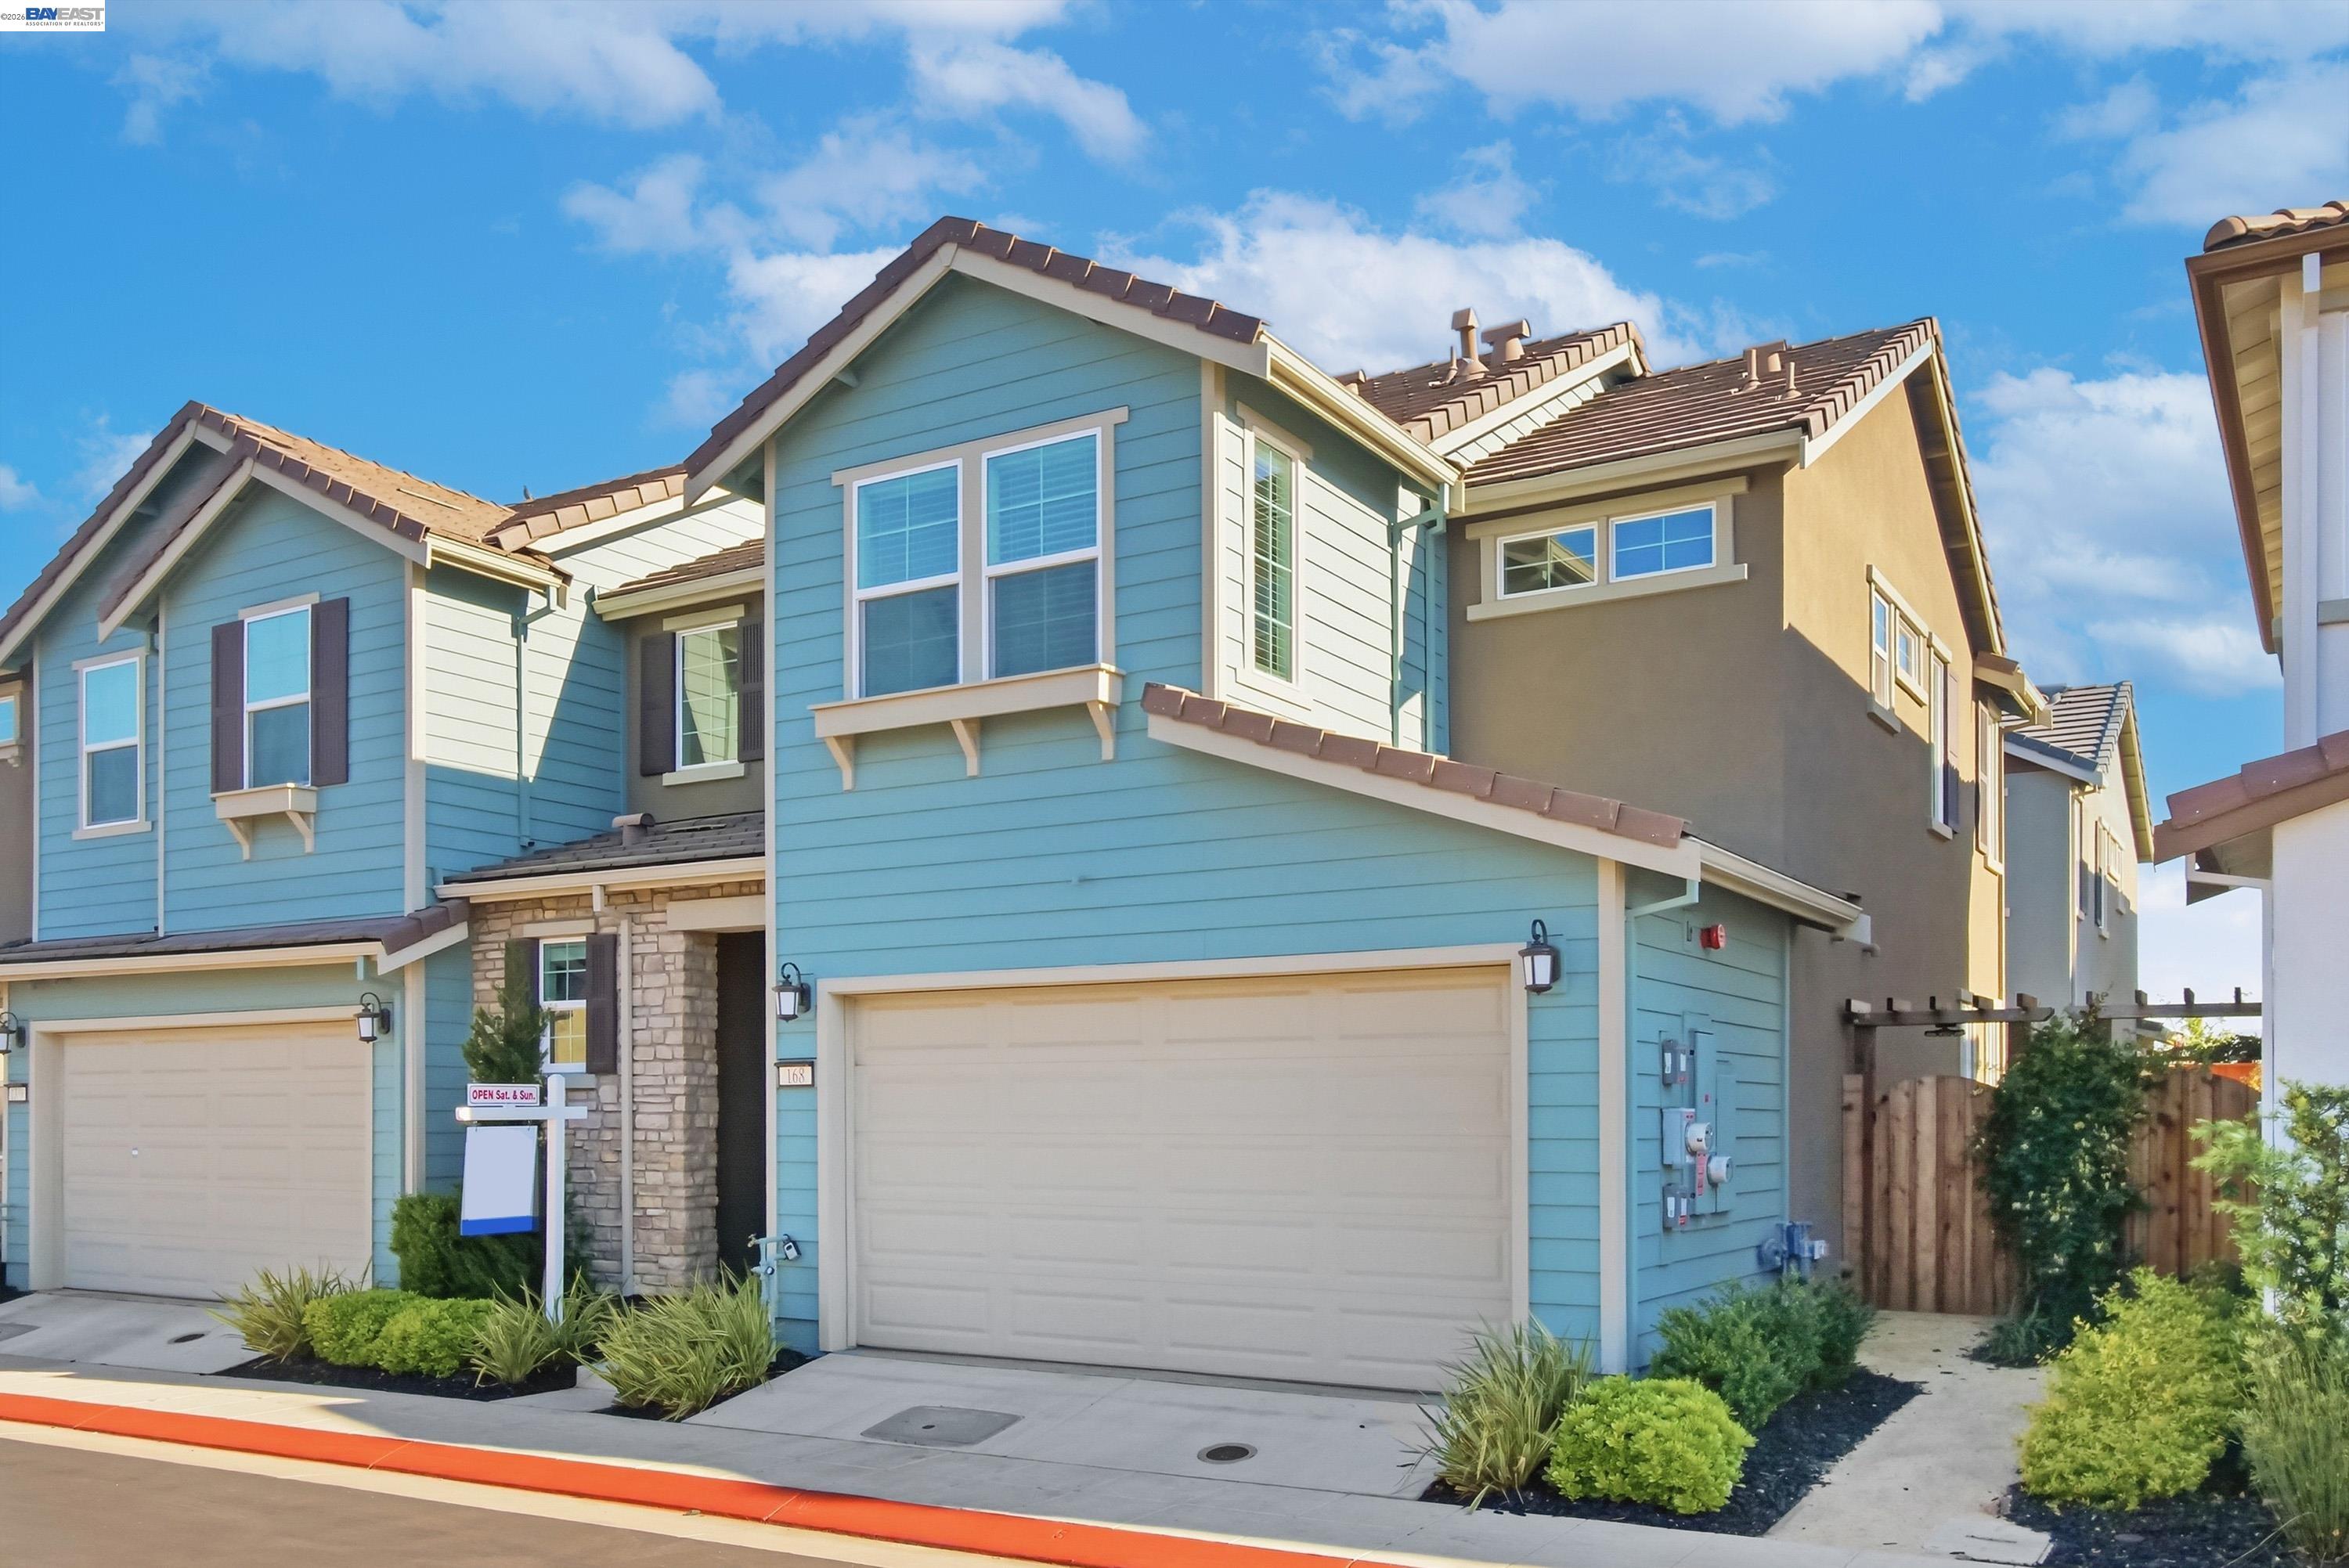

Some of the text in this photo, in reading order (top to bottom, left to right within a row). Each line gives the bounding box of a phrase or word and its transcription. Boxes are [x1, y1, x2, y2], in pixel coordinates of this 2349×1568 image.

[788, 1068, 805, 1083] 168
[472, 1090, 536, 1101] OPEN Sat. & Sun.
